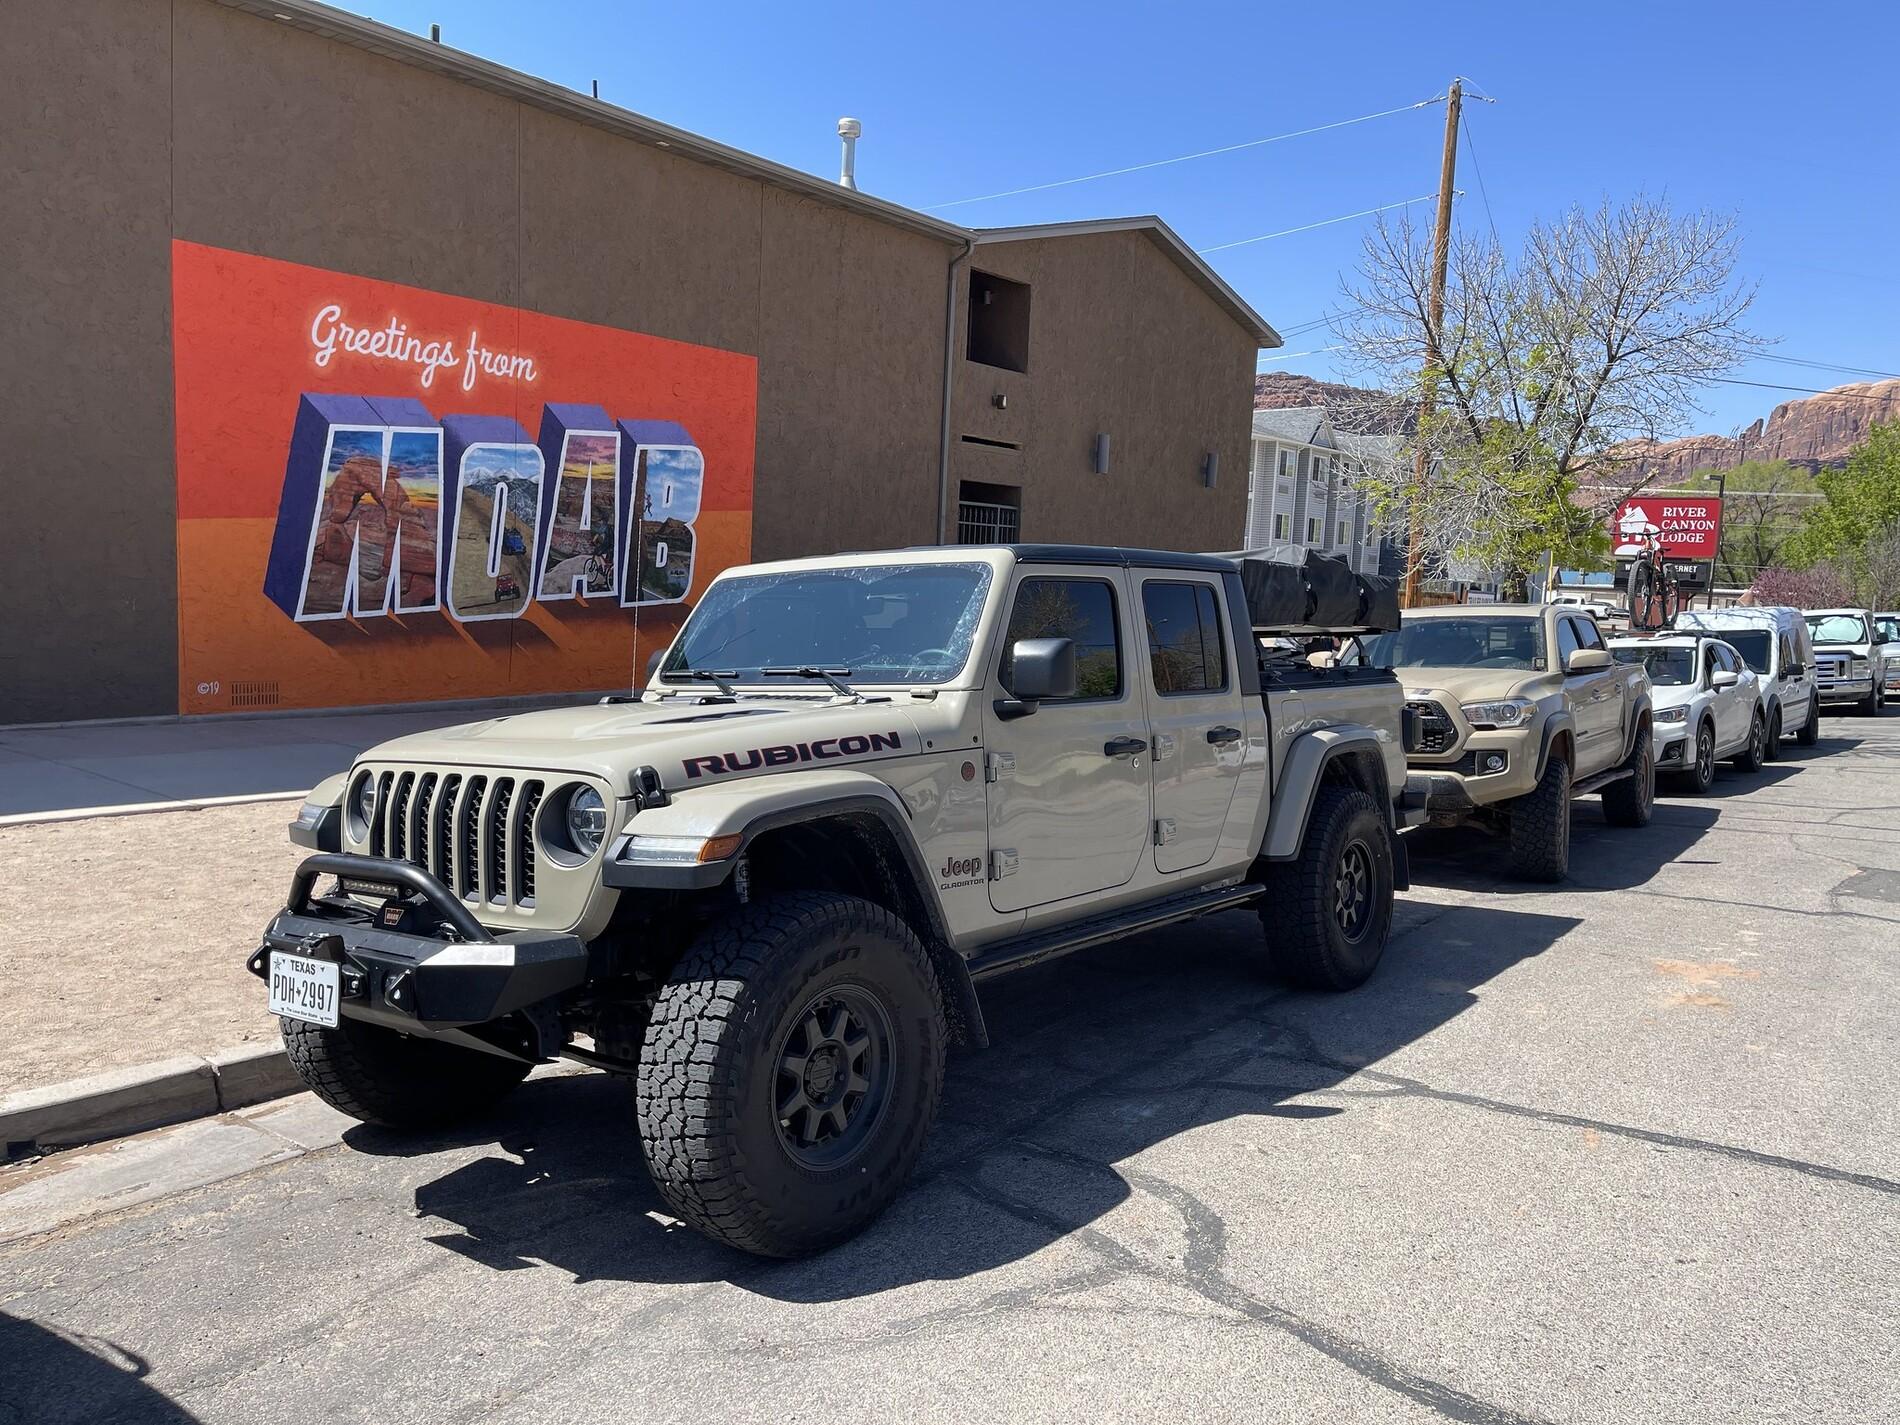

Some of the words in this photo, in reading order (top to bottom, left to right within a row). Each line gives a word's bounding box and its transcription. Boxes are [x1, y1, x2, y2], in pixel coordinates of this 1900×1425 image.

[311, 304, 459, 388] Greetings
[462, 331, 538, 392] from
[1662, 507, 1707, 517] RIVER
[293, 423, 705, 623] MOAB
[1661, 520, 1715, 531] CANYON
[1660, 532, 1705, 543] LODGE
[1674, 565, 1698, 573] ERNET
[681, 731, 902, 779] RUBICON
[941, 856, 982, 878] Jeep
[940, 878, 985, 890] GLADIATOR
[290, 959, 316, 976] TEXAS
